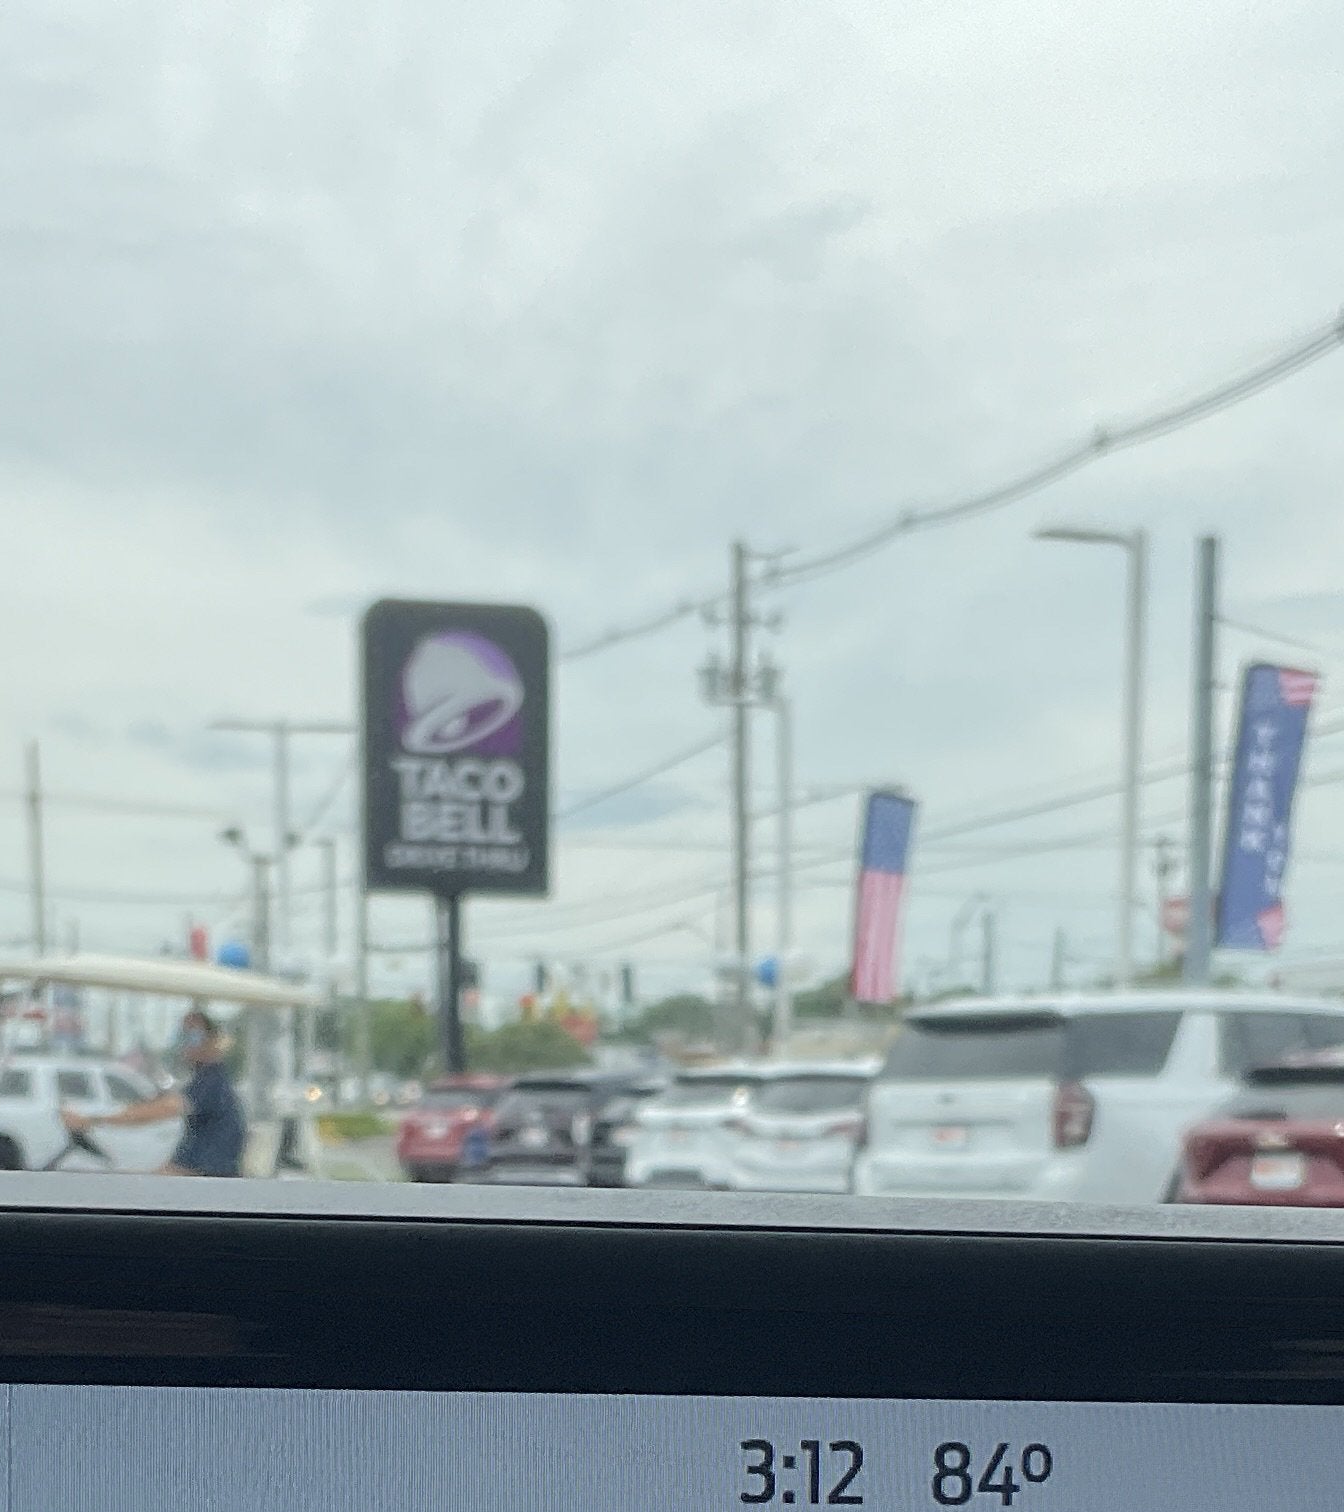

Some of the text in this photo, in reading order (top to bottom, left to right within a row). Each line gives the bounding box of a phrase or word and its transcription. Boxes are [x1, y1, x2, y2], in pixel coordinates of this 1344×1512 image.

[389, 758, 526, 803] TACO
[401, 801, 524, 844] BELL
[739, 1439, 864, 1504] 3:12
